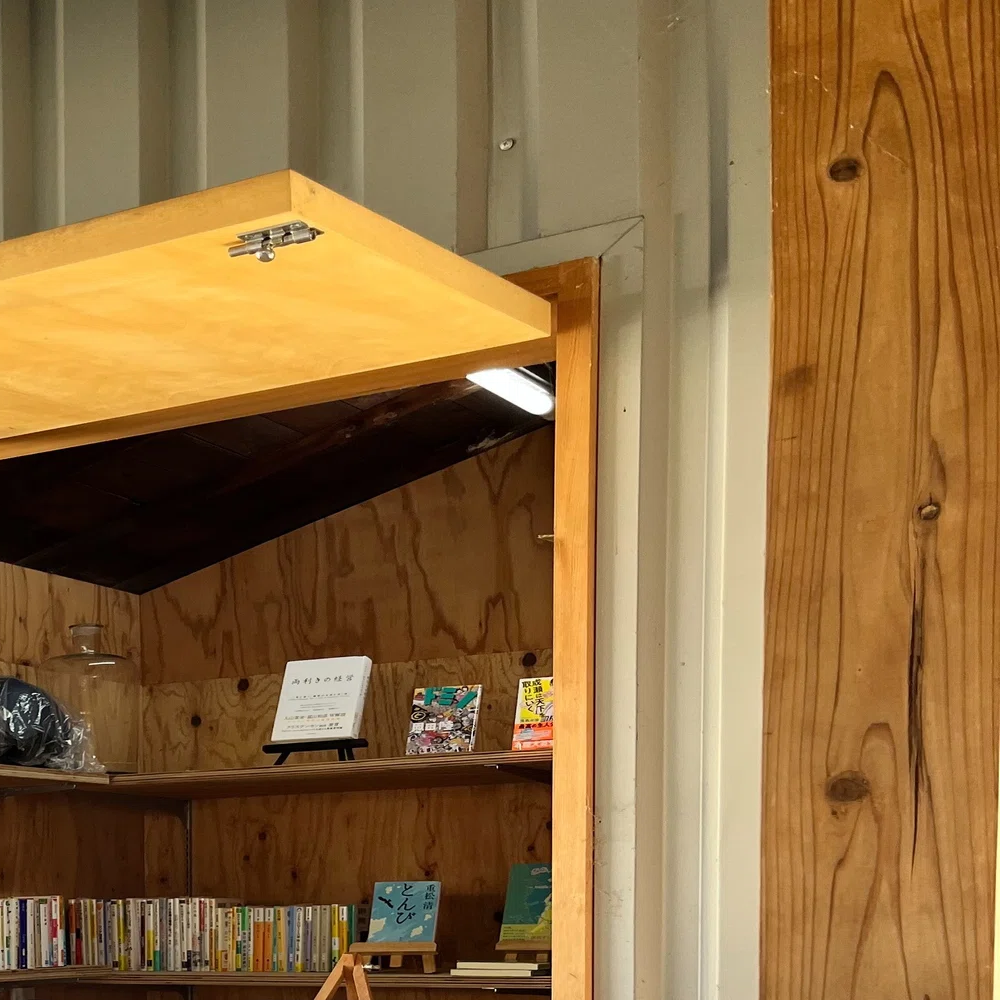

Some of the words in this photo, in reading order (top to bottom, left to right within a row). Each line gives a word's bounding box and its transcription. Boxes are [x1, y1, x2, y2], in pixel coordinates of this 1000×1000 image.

[291, 674, 355, 686] 両利きの経営
[424, 686, 478, 709] ドミノ
[521, 681, 535, 713] 取りにいく
[396, 883, 416, 925] とんび
[422, 884, 436, 910] 重松清
